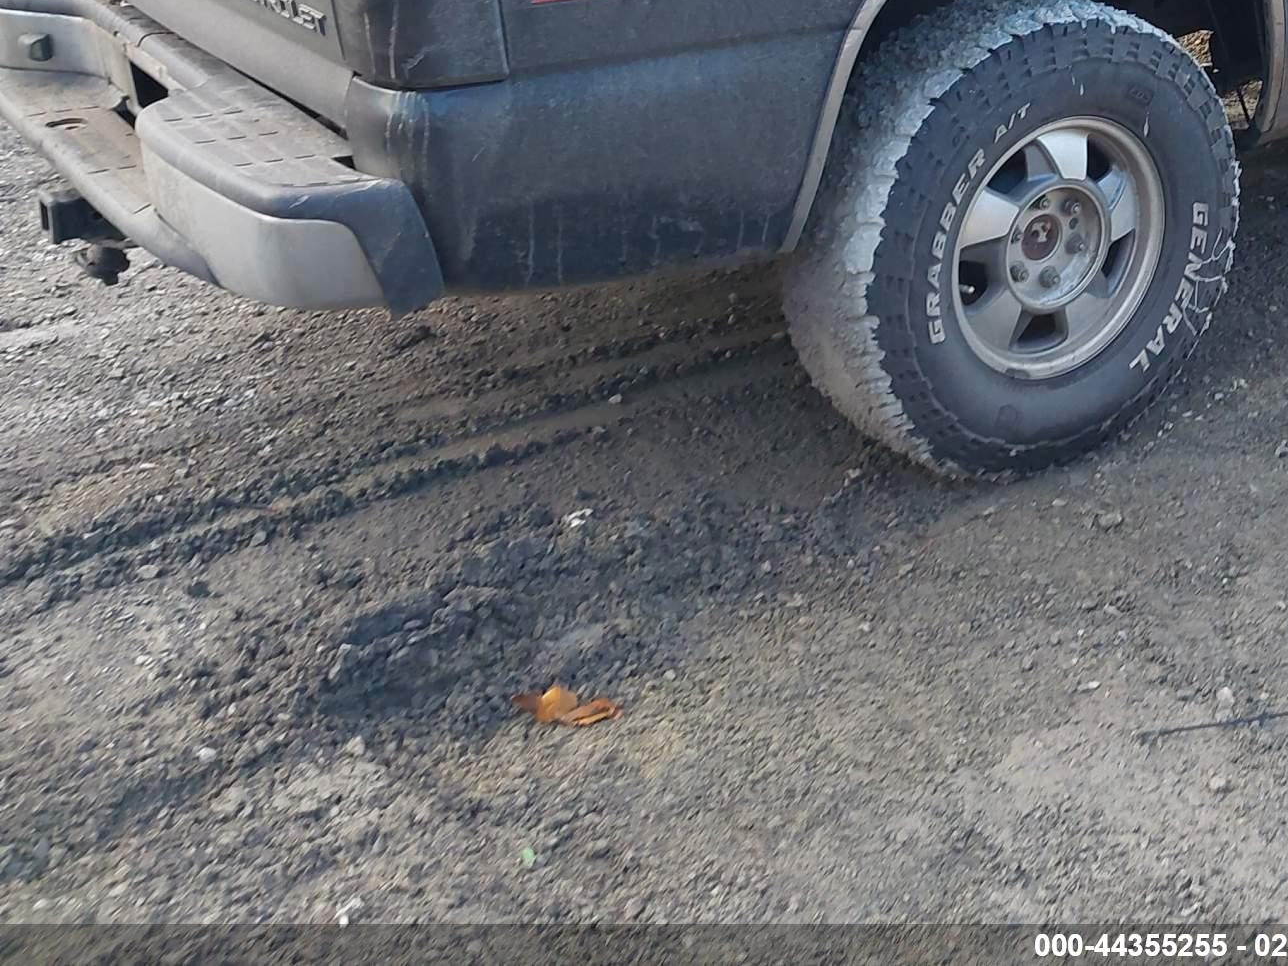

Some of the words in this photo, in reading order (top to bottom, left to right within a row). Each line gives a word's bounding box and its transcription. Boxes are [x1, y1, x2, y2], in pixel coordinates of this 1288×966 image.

[926, 148, 987, 346] GRABBER
[993, 102, 1031, 144] A/T
[1128, 201, 1210, 374] GENERAL
